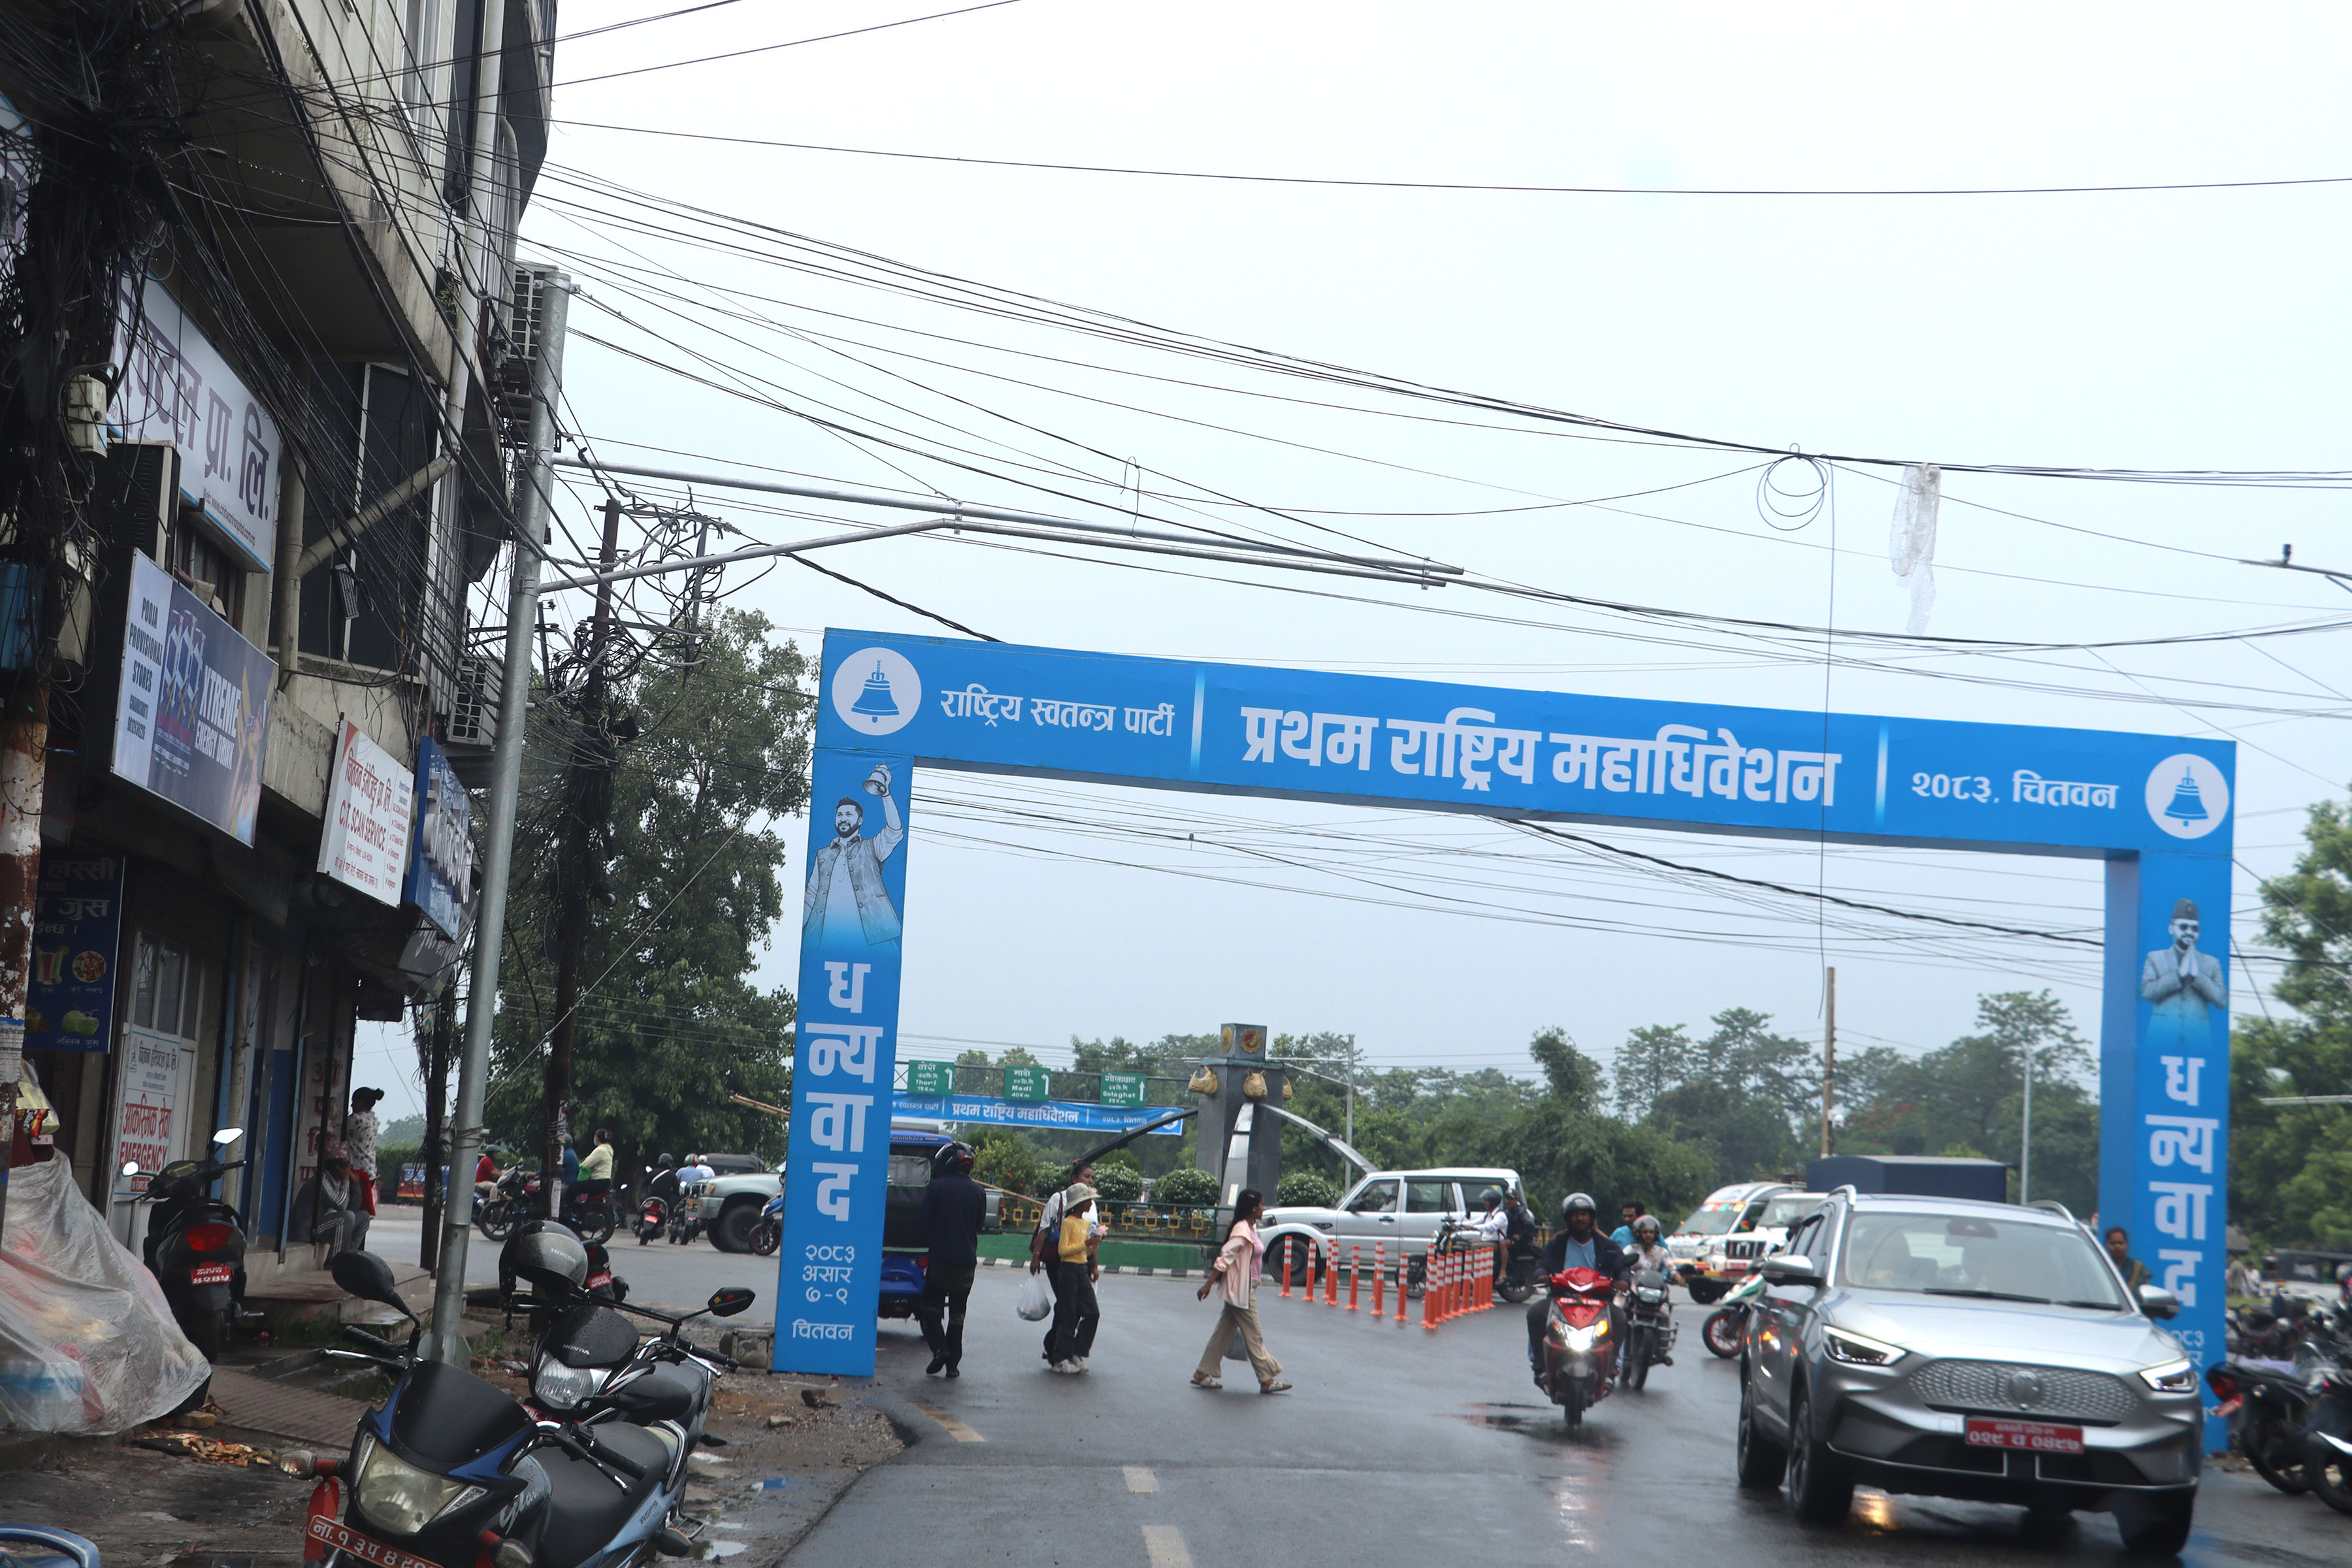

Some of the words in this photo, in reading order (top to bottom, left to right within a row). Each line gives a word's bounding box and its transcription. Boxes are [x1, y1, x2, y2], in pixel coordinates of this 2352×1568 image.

[204, 387, 233, 482] प्रा.
[239, 402, 270, 520] लि.
[141, 596, 159, 629] POOJA
[128, 622, 163, 667] PROVISIONAL
[132, 659, 153, 693] STORES
[199, 664, 242, 739] XTREME
[940, 683, 1024, 728] राष्ट्रिय
[1030, 697, 1117, 732] स्वतन्त्र
[1124, 702, 1175, 737] पार्टी
[195, 719, 219, 760] ENERGY
[216, 734, 235, 770] DRINK
[1240, 706, 1380, 772] प्रथम
[1386, 706, 1543, 792] राष्ट्रिय
[1548, 723, 1843, 807] महाधिवेशन
[2012, 768, 2120, 809] चितवन
[338, 799, 352, 831] C.T.
[350, 806, 367, 841] SCAN
[364, 816, 387, 852] SERVICE
[48, 856, 116, 880] लस्सी
[57, 896, 111, 921] जुस
[1102, 1090, 1136, 1099] Golaghat
[158, 1098, 172, 1141] सेवा
[952, 1102, 981, 1117] प्रथम
[1016, 1105, 1080, 1124] महाधिवेशन
[119, 1141, 169, 1172] EMERGENCY
[550, 1247, 576, 1264] HONDA
[805, 1245, 855, 1264] २०८३
[802, 1265, 854, 1283] असार
[792, 1318, 855, 1341] चितवन
[2170, 1330, 2205, 1348] ०८३
[562, 1343, 591, 1356] HONDA
